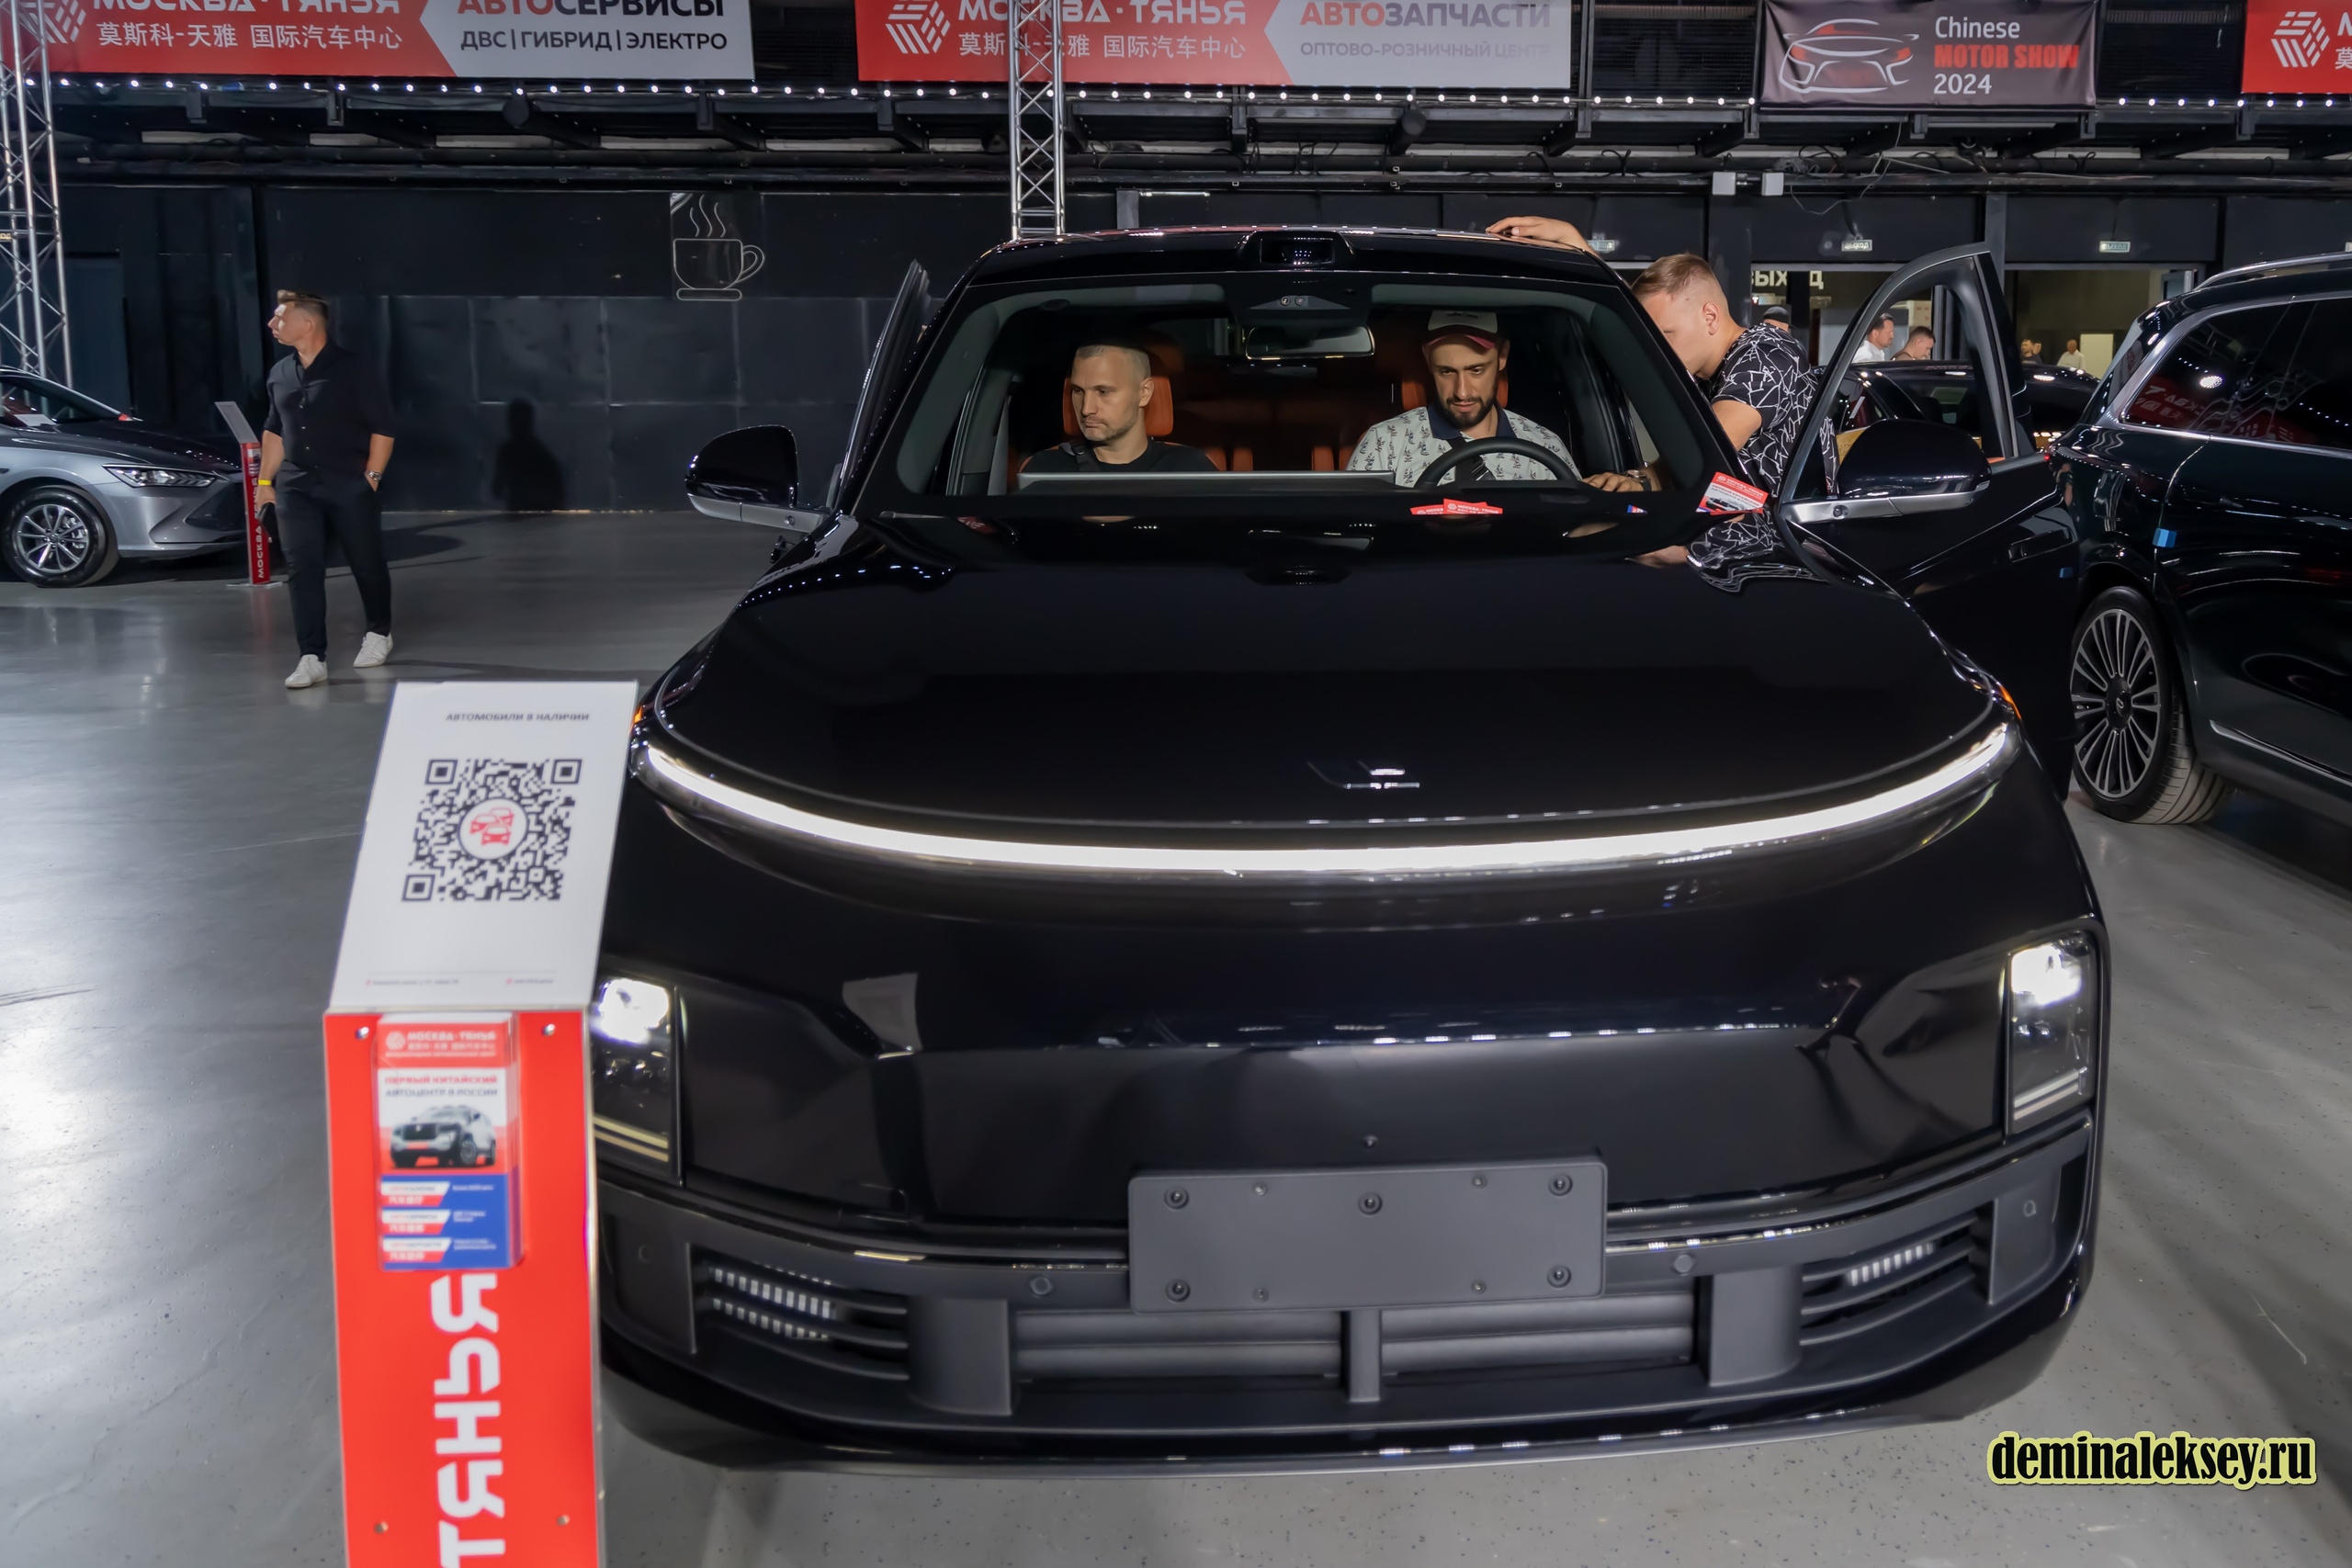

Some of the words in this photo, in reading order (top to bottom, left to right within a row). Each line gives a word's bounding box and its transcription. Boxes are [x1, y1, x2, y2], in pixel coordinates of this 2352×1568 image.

[458, 0, 724, 17] АВТОСЕРВИСЫ
[1129, 0, 1246, 24] ТЯНЬЯ
[1300, 1, 1551, 28] АВТОЗАПЧАСТИ
[96, 21, 239, 48] 莫斯科-天雅
[250, 24, 402, 50] 国际汽车中心
[1935, 16, 2020, 39] Chinese
[1103, 35, 1246, 59] 国际汽车中心
[1300, 40, 1491, 57] ОПТОВО-РОЗНИЧНЫЙ
[1934, 44, 2009, 69] MOTOR
[2014, 44, 2080, 69] SHOW
[1934, 73, 1993, 95] 2024
[1751, 270, 1824, 290] ЫХД
[255, 525, 265, 579] МОСКВА
[446, 713, 524, 721] АВТОМОБИЛИ
[536, 713, 590, 721] НАЛИЧИИ
[430, 1273, 505, 1568] ТЯНЬЯ
